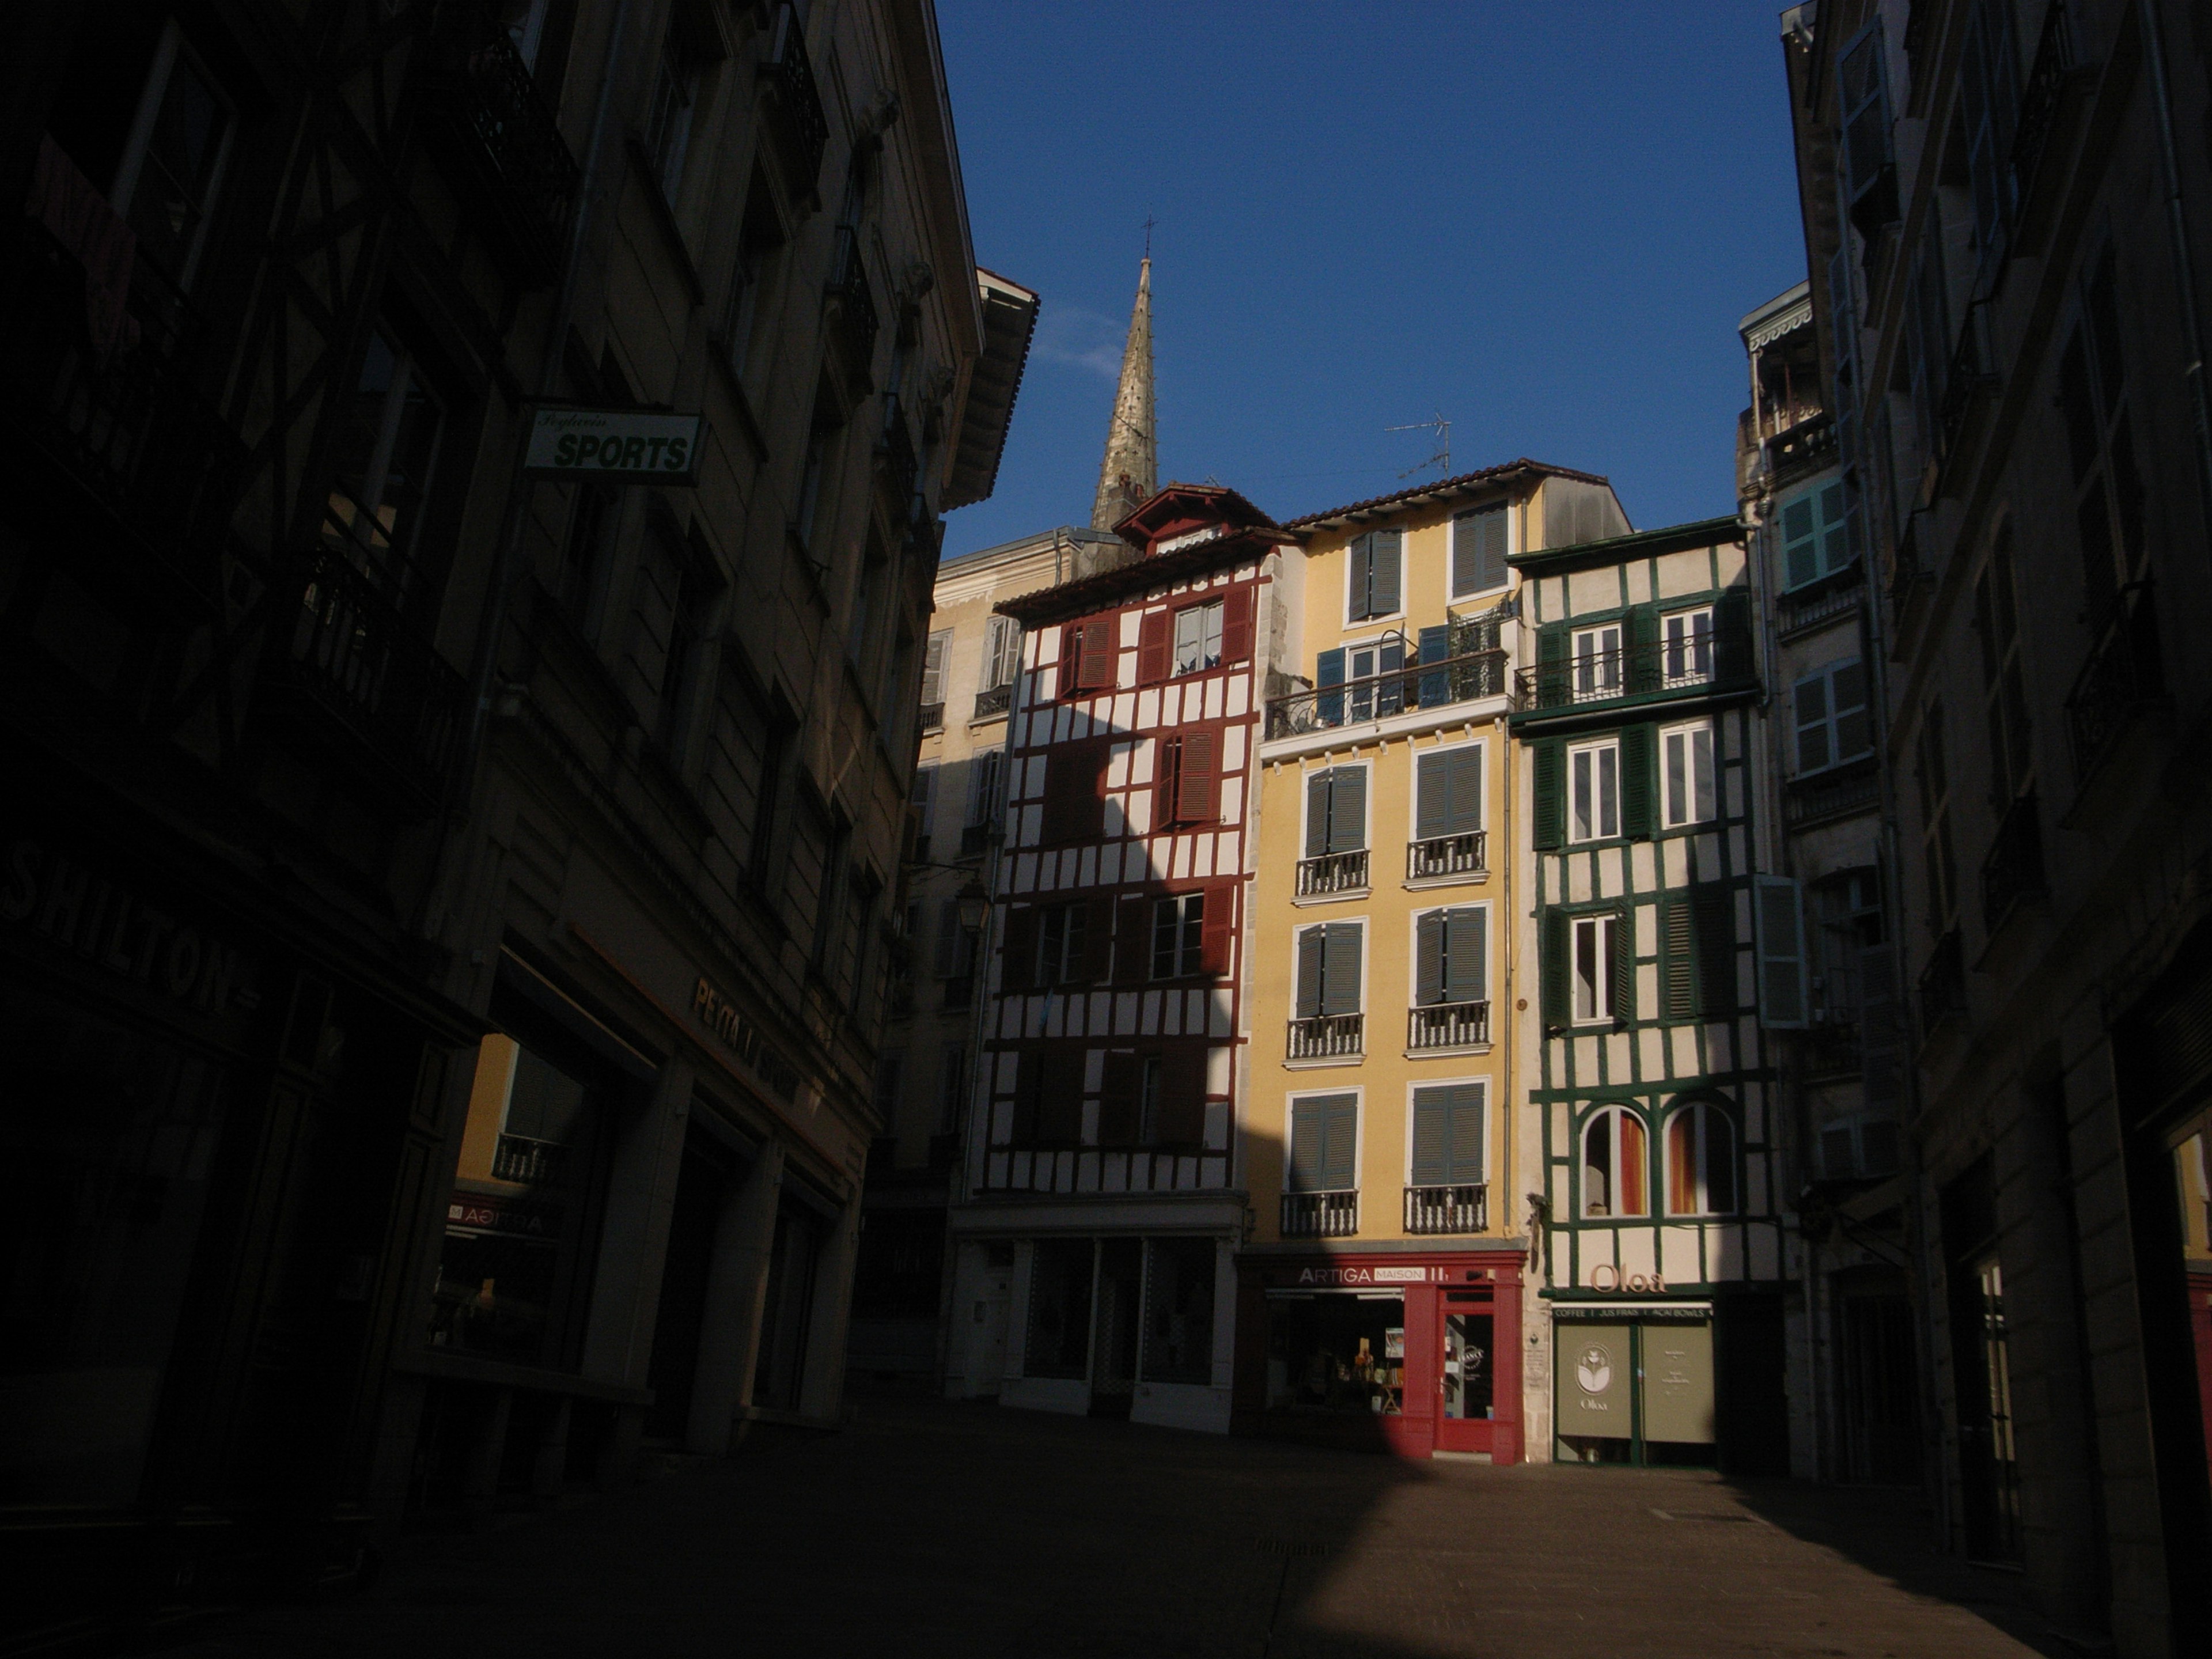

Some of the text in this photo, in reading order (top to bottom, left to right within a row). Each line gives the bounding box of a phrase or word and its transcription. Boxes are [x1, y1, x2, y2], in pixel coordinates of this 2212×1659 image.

[555, 434, 688, 470] SPORTS
[0, 839, 237, 1016] SHILTON
[1299, 1267, 1422, 1283] ARTIGA MAISON
[1590, 1263, 1668, 1293] Oloa
[1555, 1308, 1585, 1317] COFFEE
[1599, 1308, 1615, 1317] JUS
[1673, 1308, 1704, 1317] BOWLS
